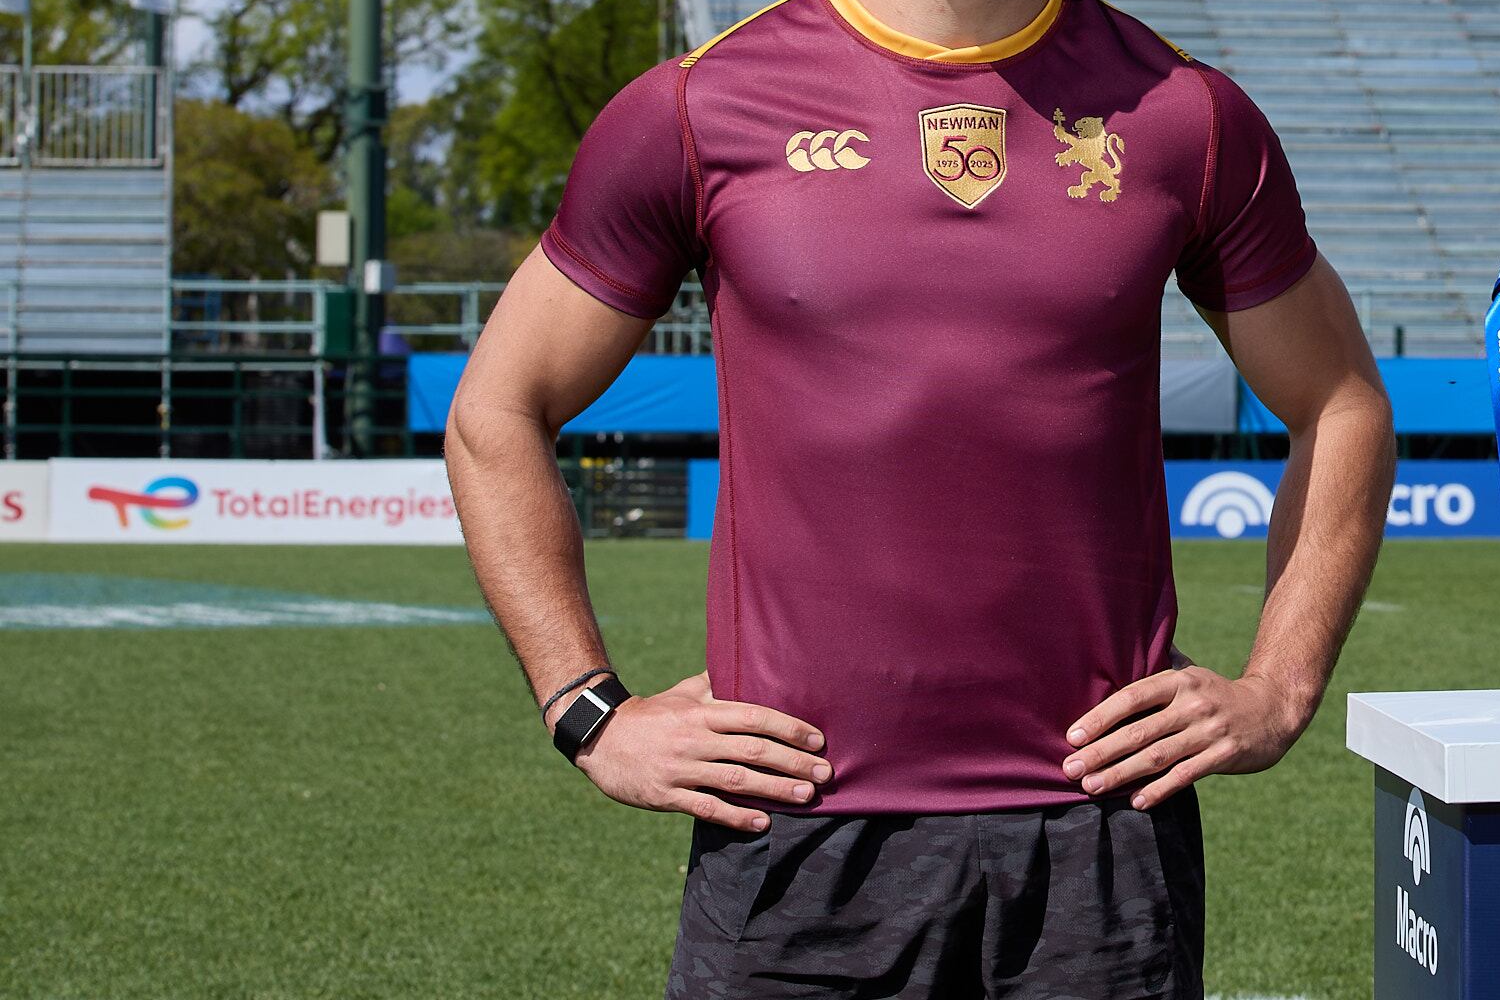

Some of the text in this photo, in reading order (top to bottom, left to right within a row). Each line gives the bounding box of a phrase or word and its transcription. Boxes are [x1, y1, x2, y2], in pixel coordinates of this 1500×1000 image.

[927, 117, 999, 130] NEWMAN
[932, 135, 1001, 181] 50
[936, 160, 993, 168] 1975 2025
[212, 488, 457, 526] TotalEnergies
[1386, 482, 1476, 526] cro
[1396, 884, 1439, 977] Macro
